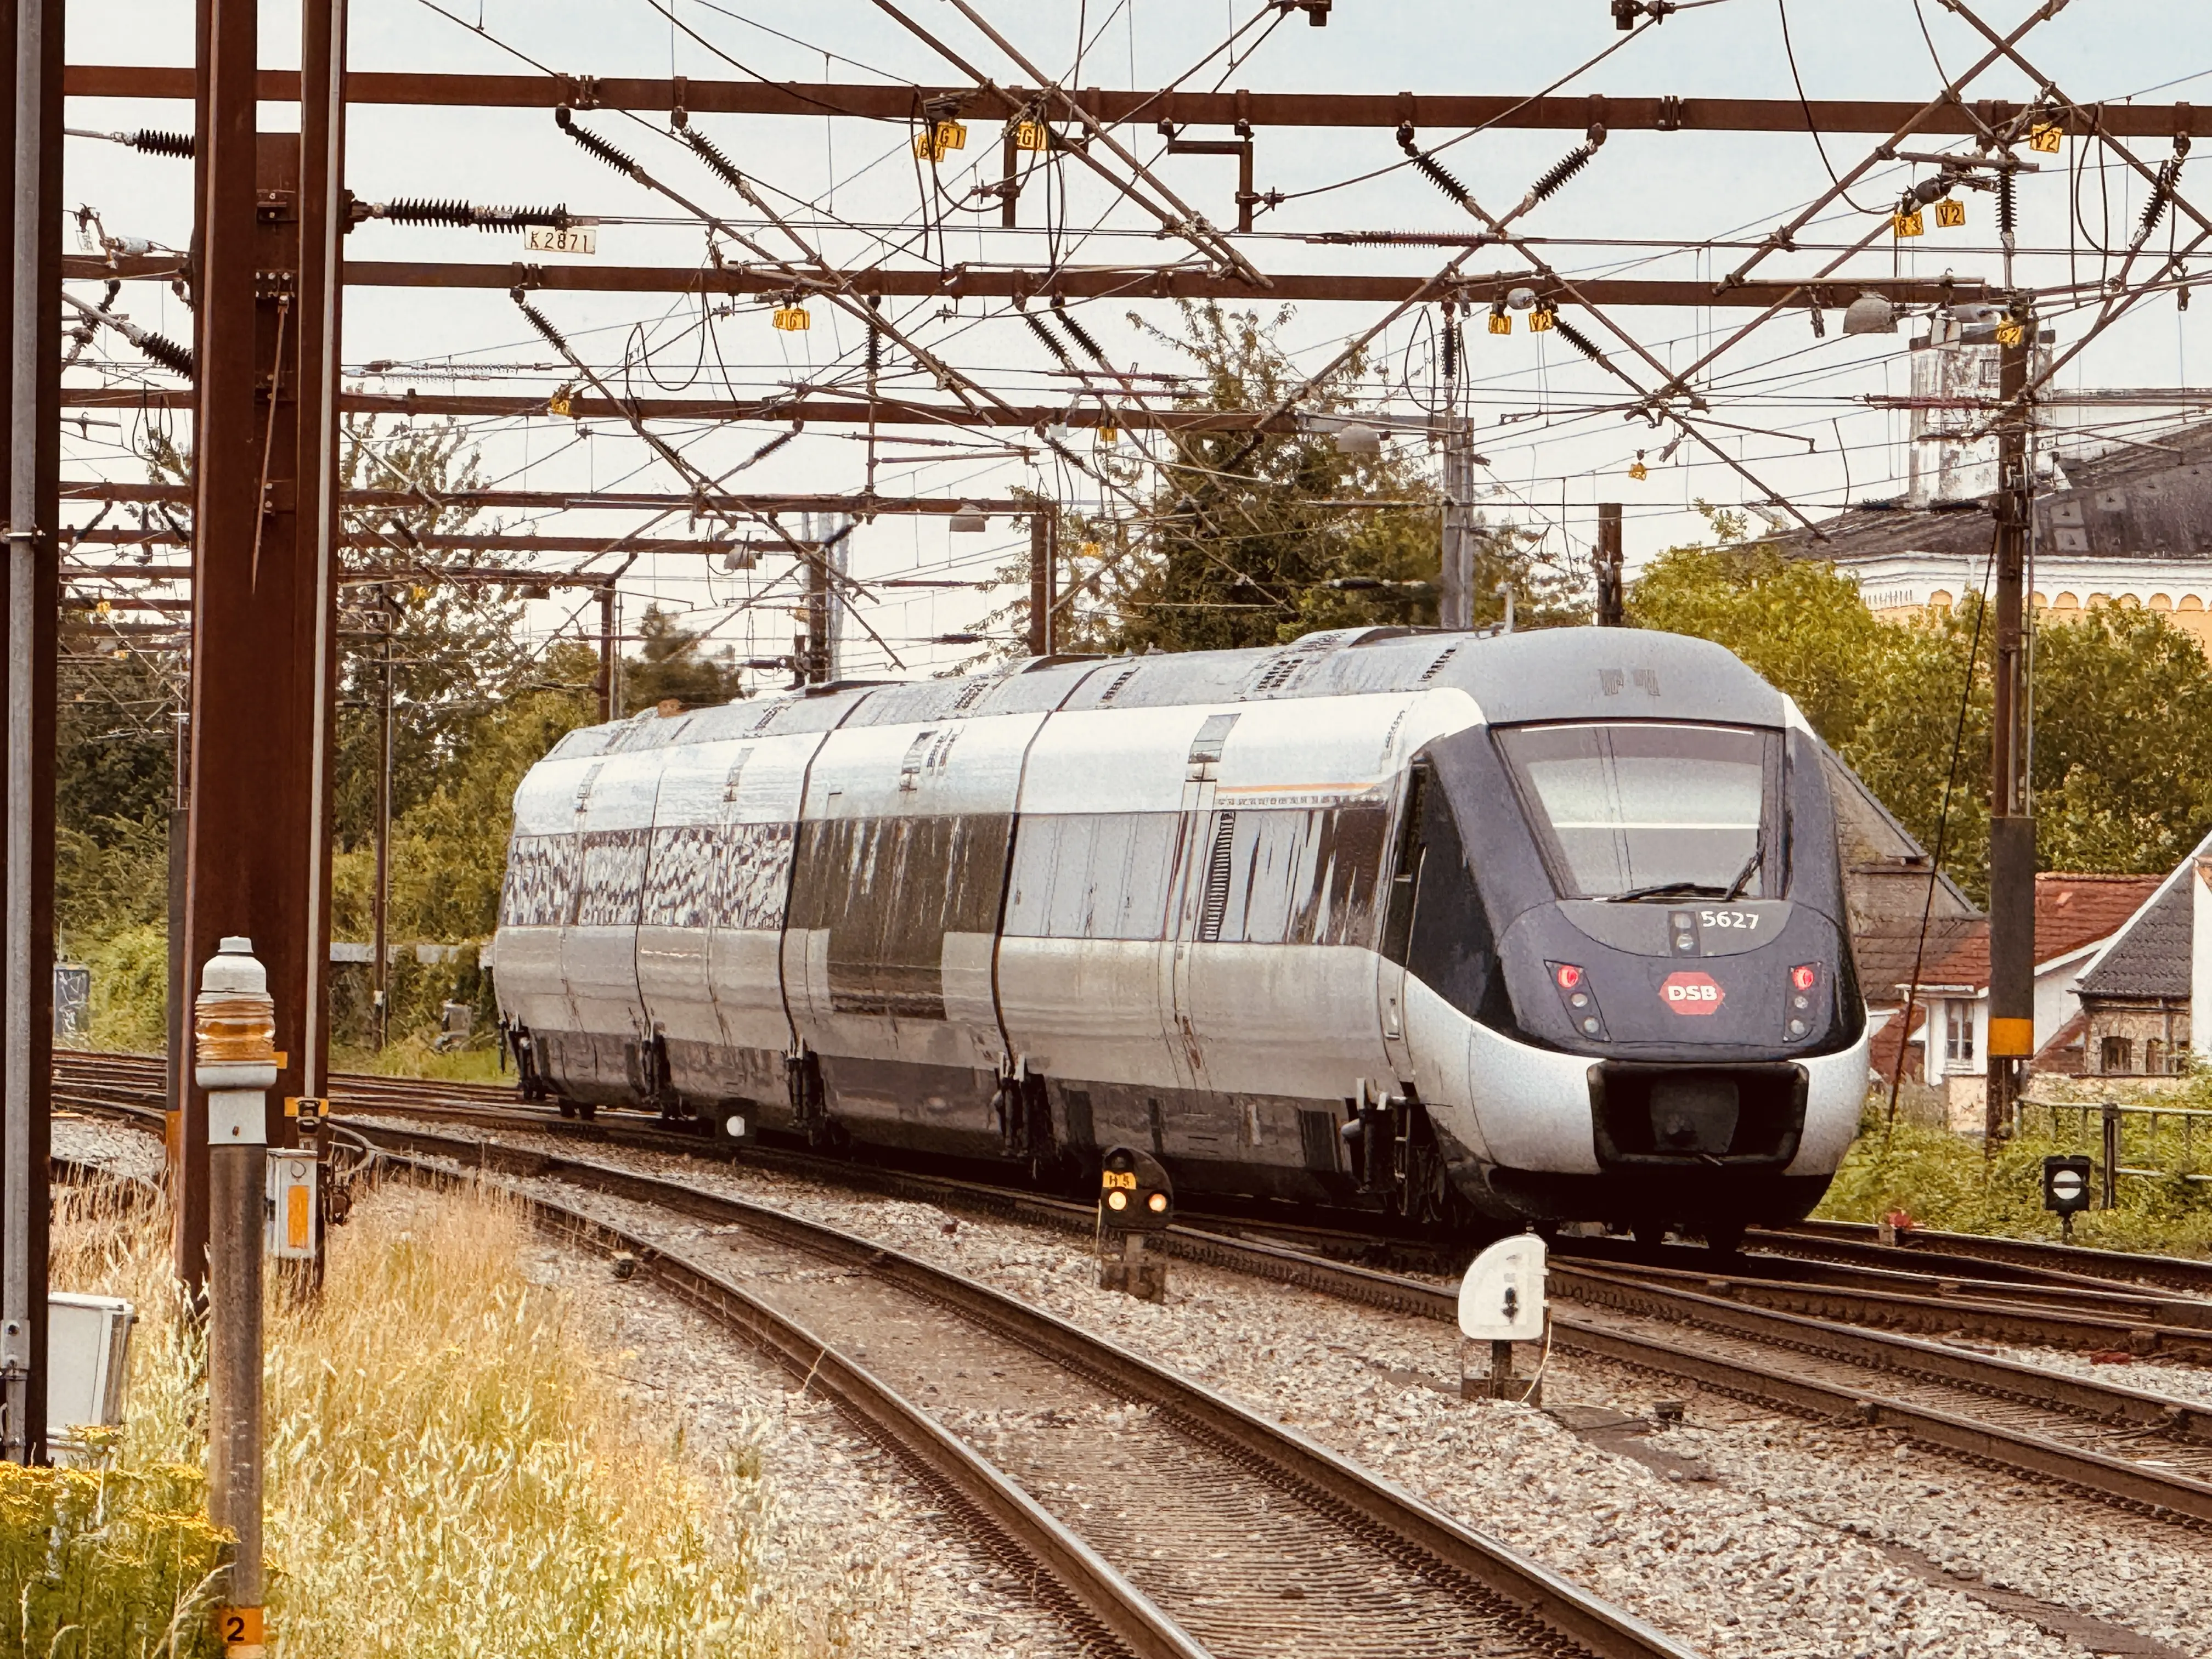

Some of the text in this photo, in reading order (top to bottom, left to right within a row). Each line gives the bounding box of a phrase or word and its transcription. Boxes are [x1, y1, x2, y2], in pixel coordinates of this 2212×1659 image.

[1940, 206, 1961, 224] V2
[1701, 911, 1759, 929] 5627
[1668, 985, 1717, 1001] DSB
[227, 1616, 245, 1641] 2
